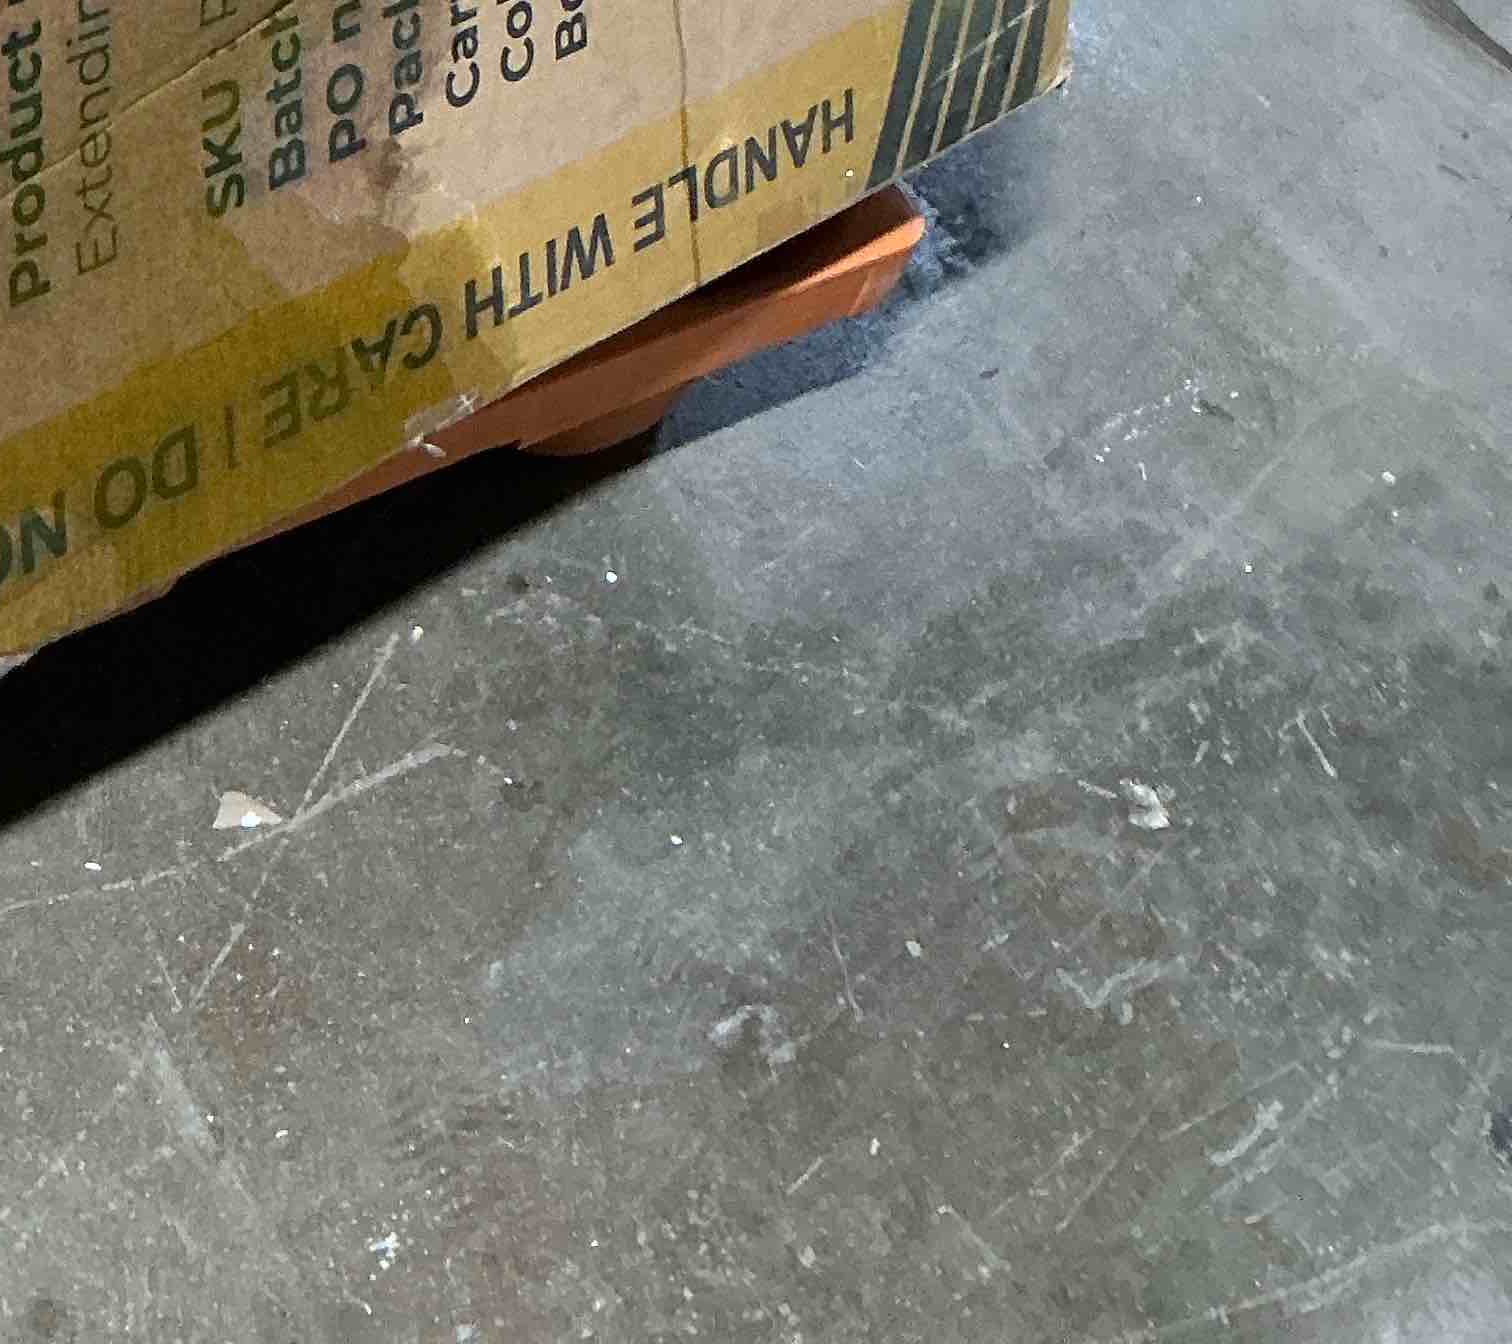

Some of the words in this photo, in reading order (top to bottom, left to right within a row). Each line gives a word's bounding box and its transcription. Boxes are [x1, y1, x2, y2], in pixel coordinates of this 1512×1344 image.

[201, 78, 246, 218] SKU
[326, 62, 367, 164] PO
[631, 87, 855, 255] HANDLE
[463, 215, 616, 340] WITH
[259, 300, 444, 449] CARE
[92, 424, 201, 533] DO
